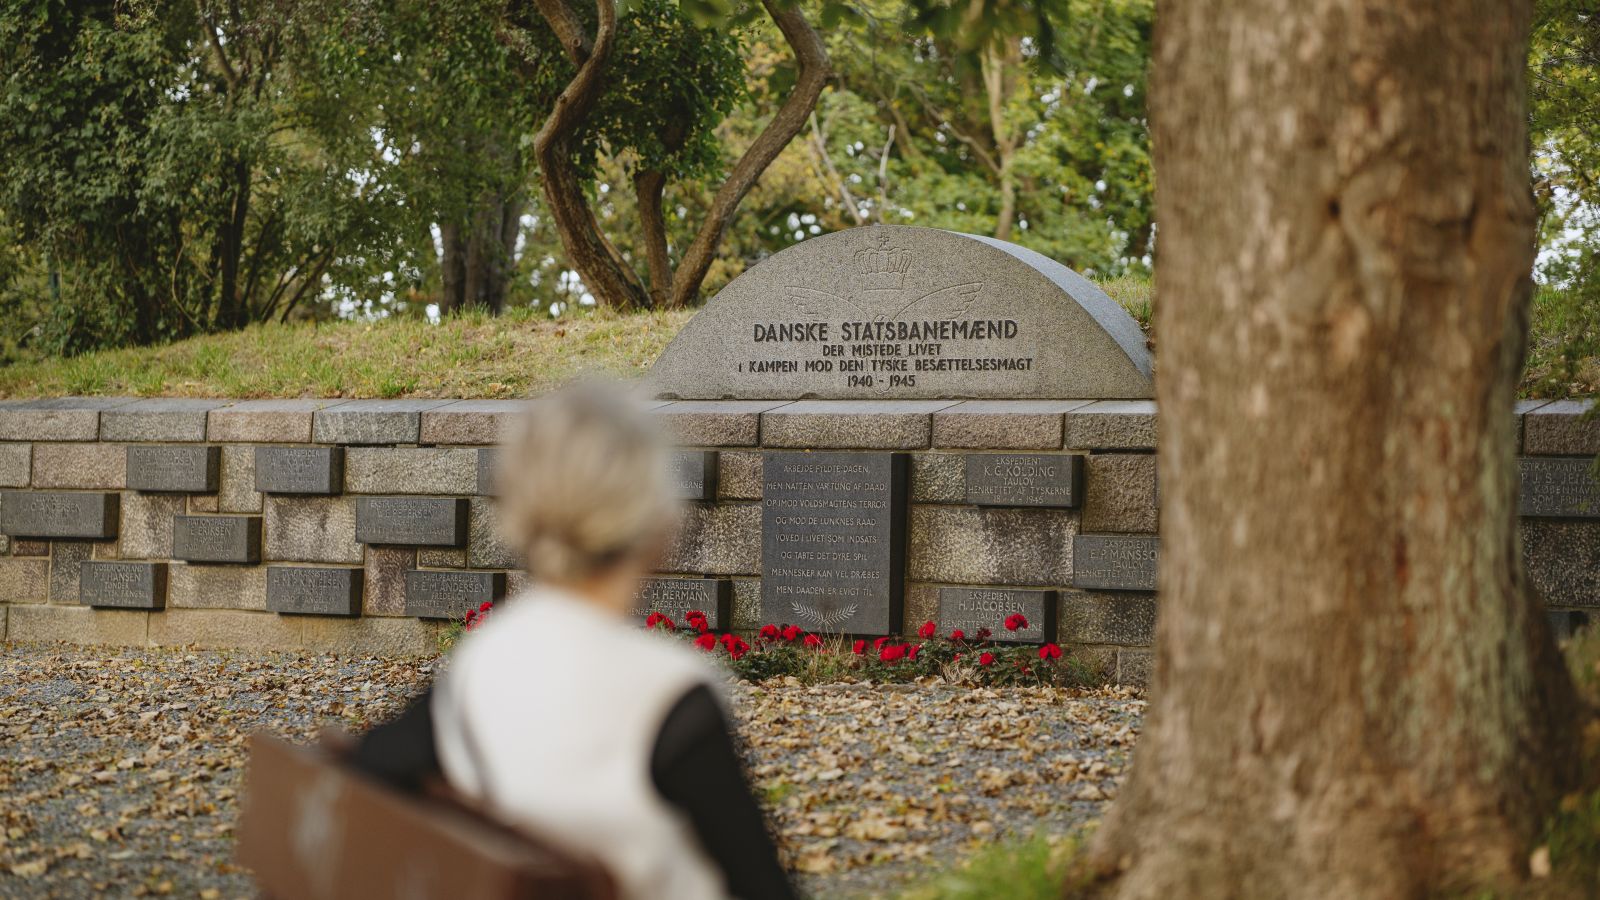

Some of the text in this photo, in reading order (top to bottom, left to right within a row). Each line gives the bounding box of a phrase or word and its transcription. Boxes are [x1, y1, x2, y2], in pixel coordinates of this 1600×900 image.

[754, 320, 1018, 342] DANSKE STATSBANEMÆND
[823, 343, 942, 357] DER MISTEDE LIVET
[749, 361, 797, 373] KAMPEN
[805, 360, 833, 372] MOD
[839, 359, 864, 372] DEN
[872, 359, 908, 372] TYSKE
[915, 358, 1033, 372] BESÆTTELSESMAGT
[847, 375, 873, 388] 1940
[889, 374, 916, 388] 1945
[996, 457, 1041, 465] EKSPEDIENT
[784, 464, 813, 473] ARBEJDE
[1006, 466, 1055, 477] KOLDING
[766, 482, 783, 490] MEN
[830, 483, 851, 491] TUNG
[853, 483, 862, 491] AF
[1003, 477, 1035, 486] TAULOV
[968, 486, 1072, 496] HENRETTET AF TYSKERNE
[800, 500, 857, 508] VOLDSMAGTENS
[859, 500, 887, 509] TERROR
[775, 516, 787, 525] OG
[789, 517, 805, 525] MOD
[808, 517, 818, 525] DE
[775, 534, 800, 542] VOVED
[794, 552, 815, 560] TABTE
[817, 552, 830, 560] DET
[832, 552, 850, 560] DYRE
[1110, 549, 1160, 561] MANSSO
[107, 572, 141, 583] HANSEN
[771, 568, 815, 577] MENNESKER
[817, 569, 833, 578] KAN
[835, 570, 849, 578] VEL
[440, 582, 486, 593] ANDERSEN
[640, 580, 705, 591] STATIONSARBEJDER
[662, 590, 710, 602] HERMANN
[776, 586, 793, 594] MEN
[796, 586, 825, 594] DAADEN
[828, 587, 837, 595] ER
[839, 588, 859, 596] EVIGT
[969, 591, 1015, 601] EKSPEDIENT
[651, 600, 691, 609] FREDERICIA
[970, 600, 1025, 613] JACOBSEN
